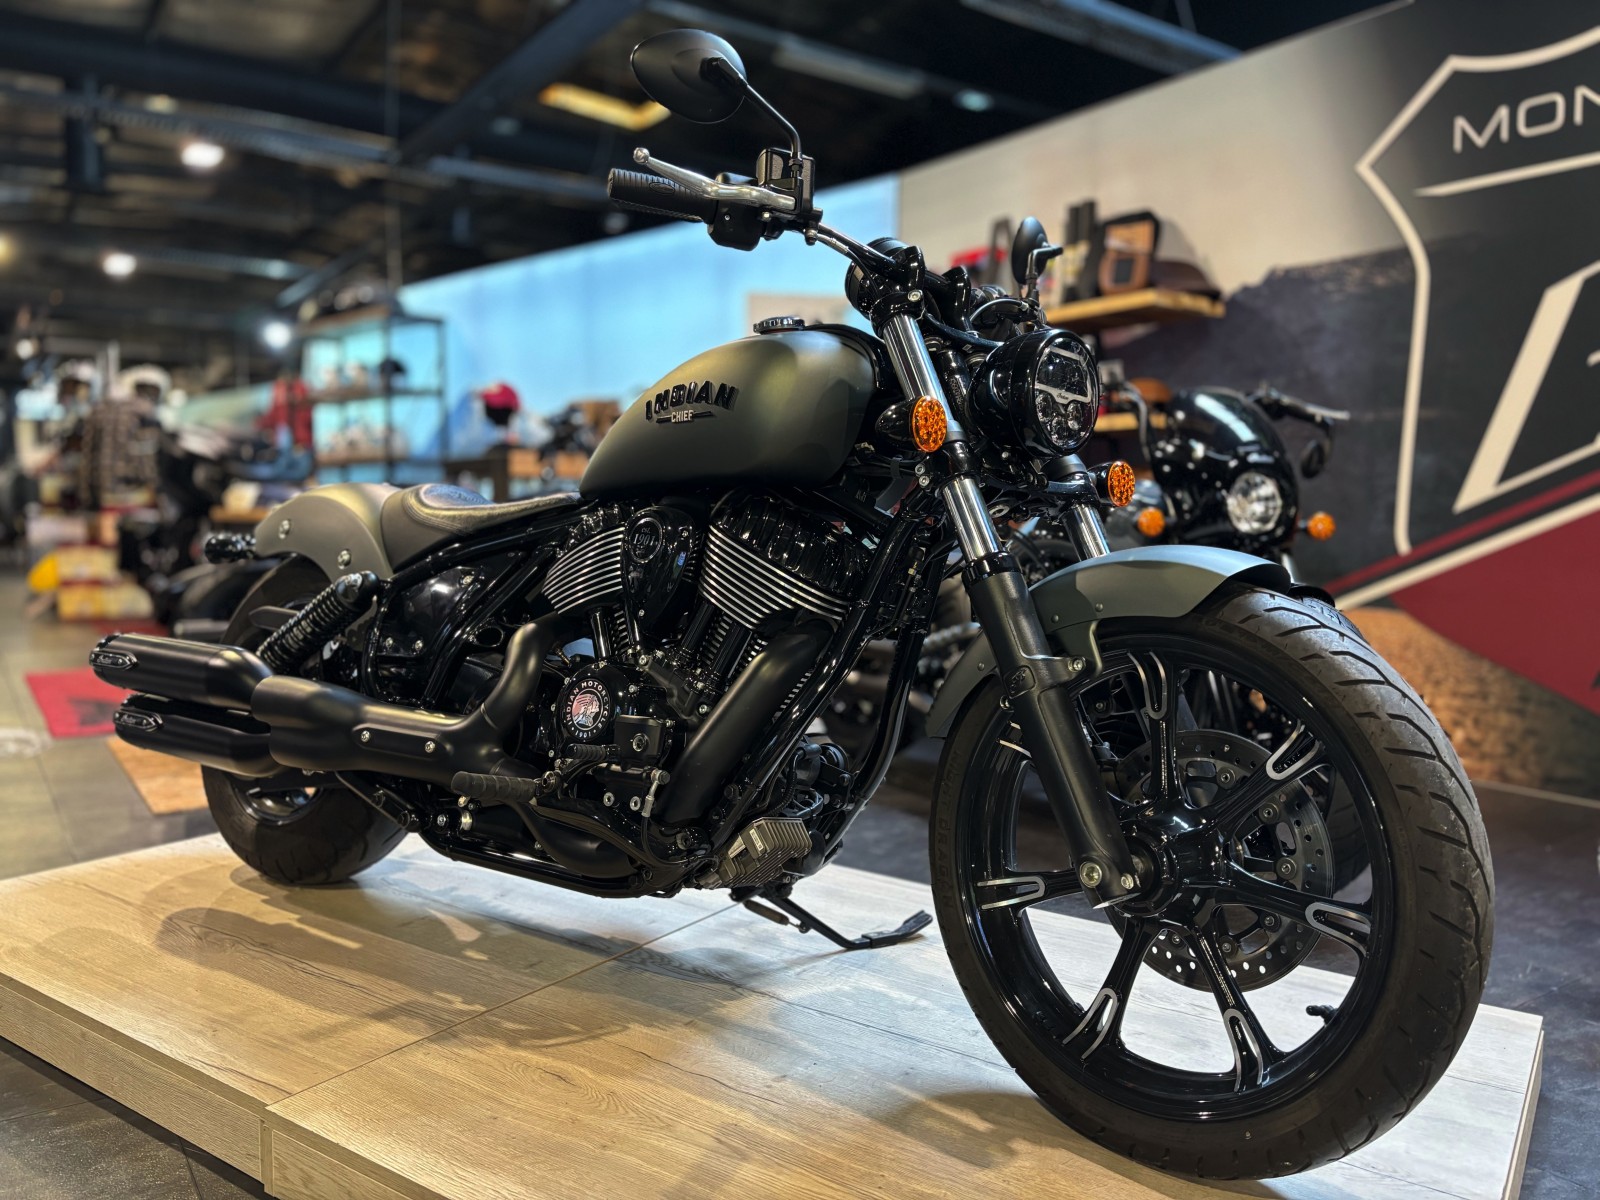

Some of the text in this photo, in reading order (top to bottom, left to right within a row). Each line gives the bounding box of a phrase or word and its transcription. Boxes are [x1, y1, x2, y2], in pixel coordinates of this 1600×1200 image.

[645, 380, 738, 421] INDIAN
[671, 409, 694, 423] CHIEF
[633, 533, 656, 546] 1901
[566, 680, 609, 729] INDIAN MOTORCYCLE
